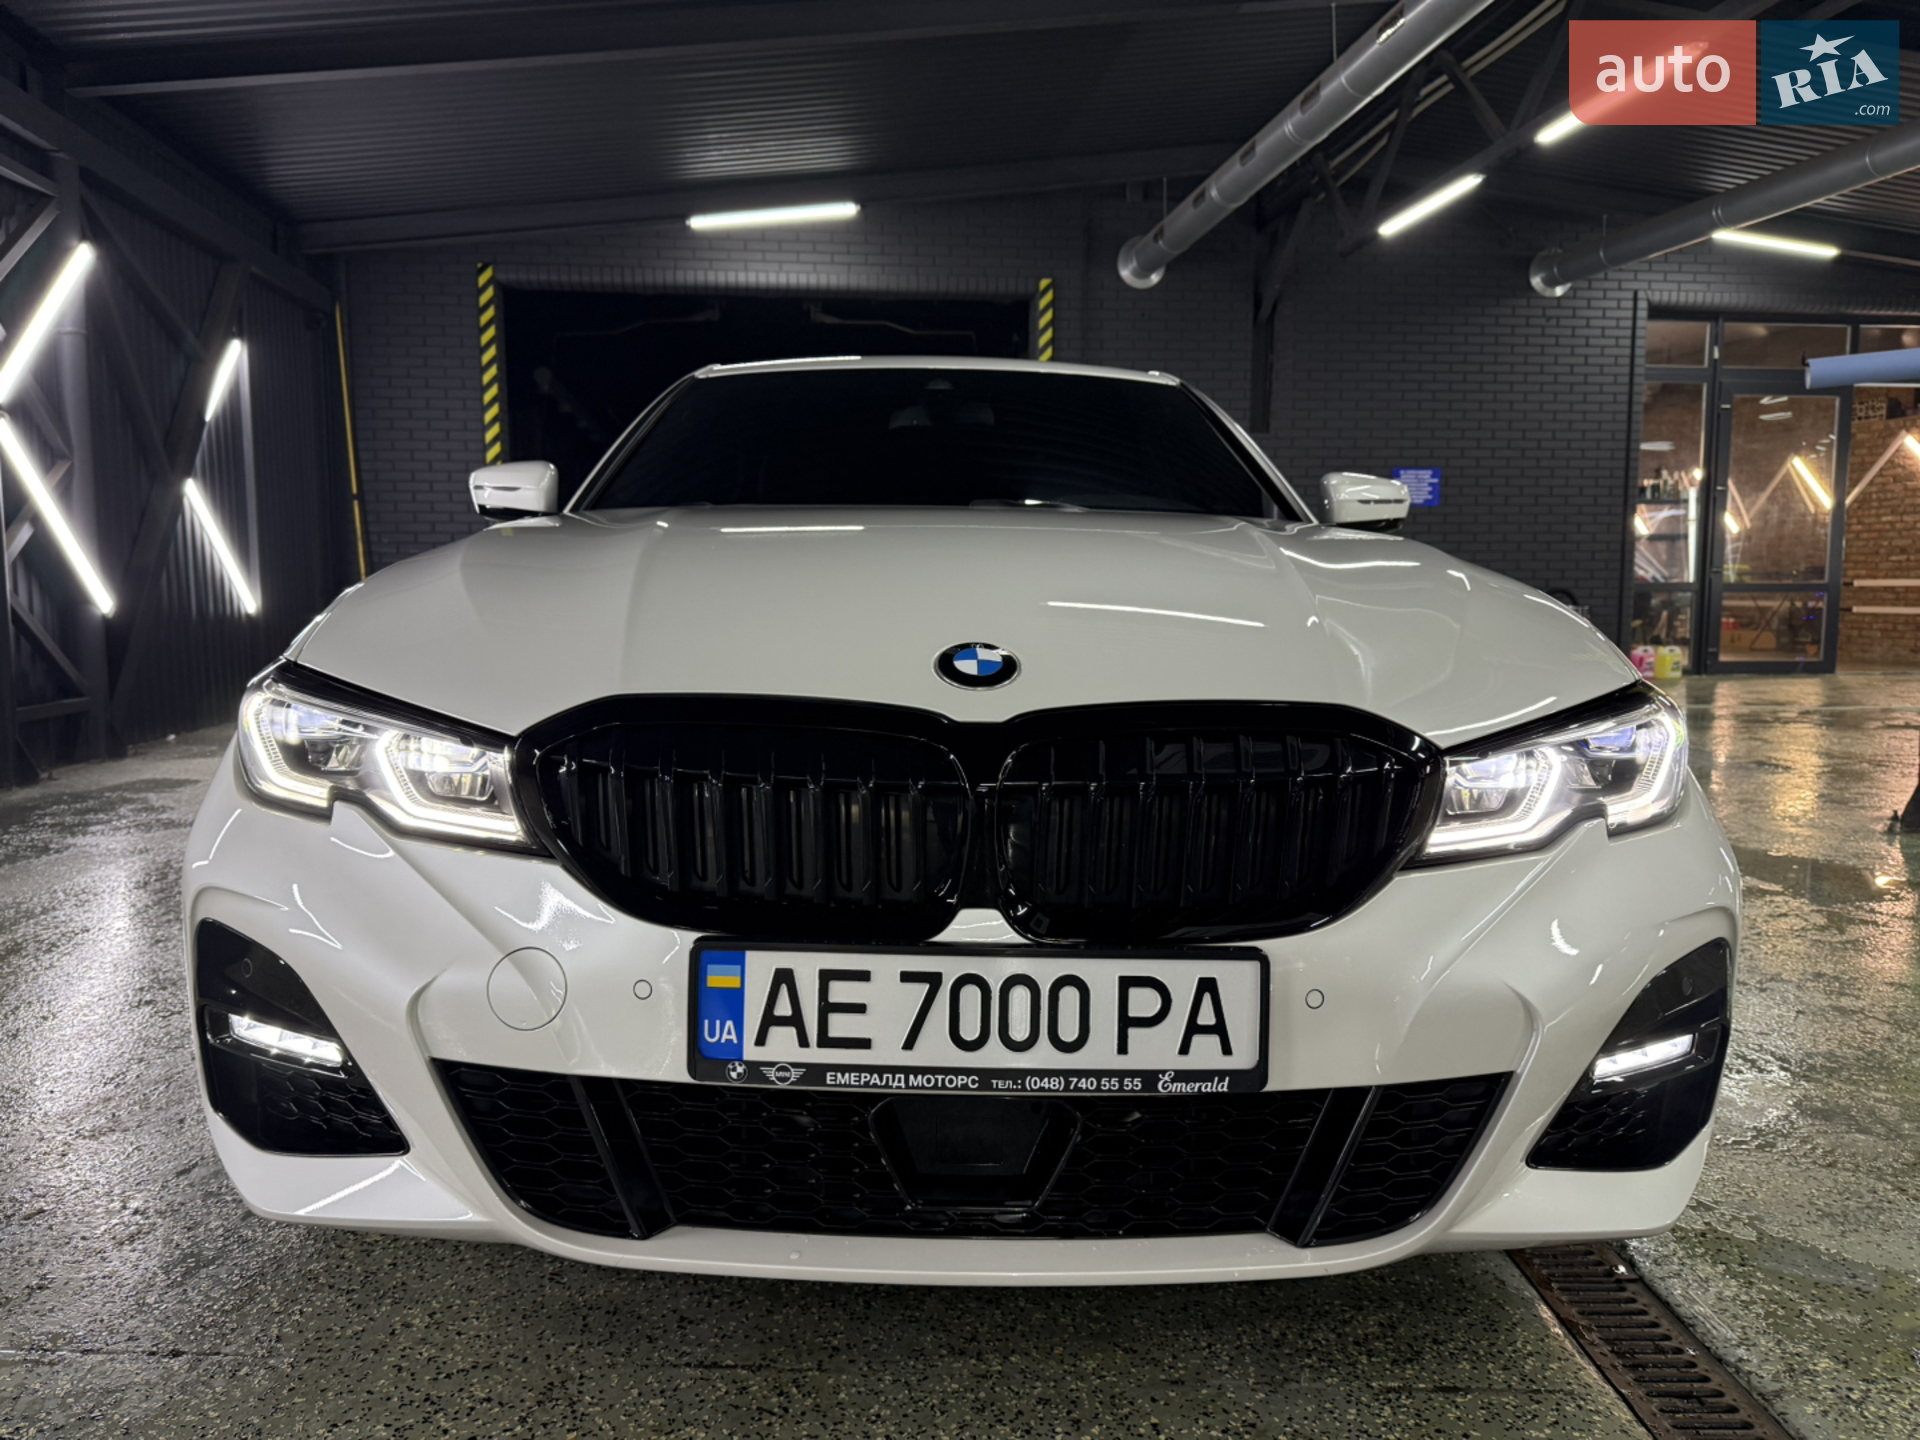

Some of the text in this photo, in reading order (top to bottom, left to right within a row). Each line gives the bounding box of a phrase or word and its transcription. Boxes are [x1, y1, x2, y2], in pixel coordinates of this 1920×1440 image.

[754, 967, 1233, 1057] AE 7000 PA
[704, 1020, 738, 1044] UA
[826, 1072, 905, 1088] ЕМЕРАЛД
[908, 1073, 979, 1089] МОТОРС
[1025, 1075, 1065, 1091] (048)
[1069, 1077, 1097, 1090] 740
[1100, 1078, 1119, 1090] 55
[1123, 1078, 1142, 1091] 55
[1157, 1070, 1230, 1093] Emerald
